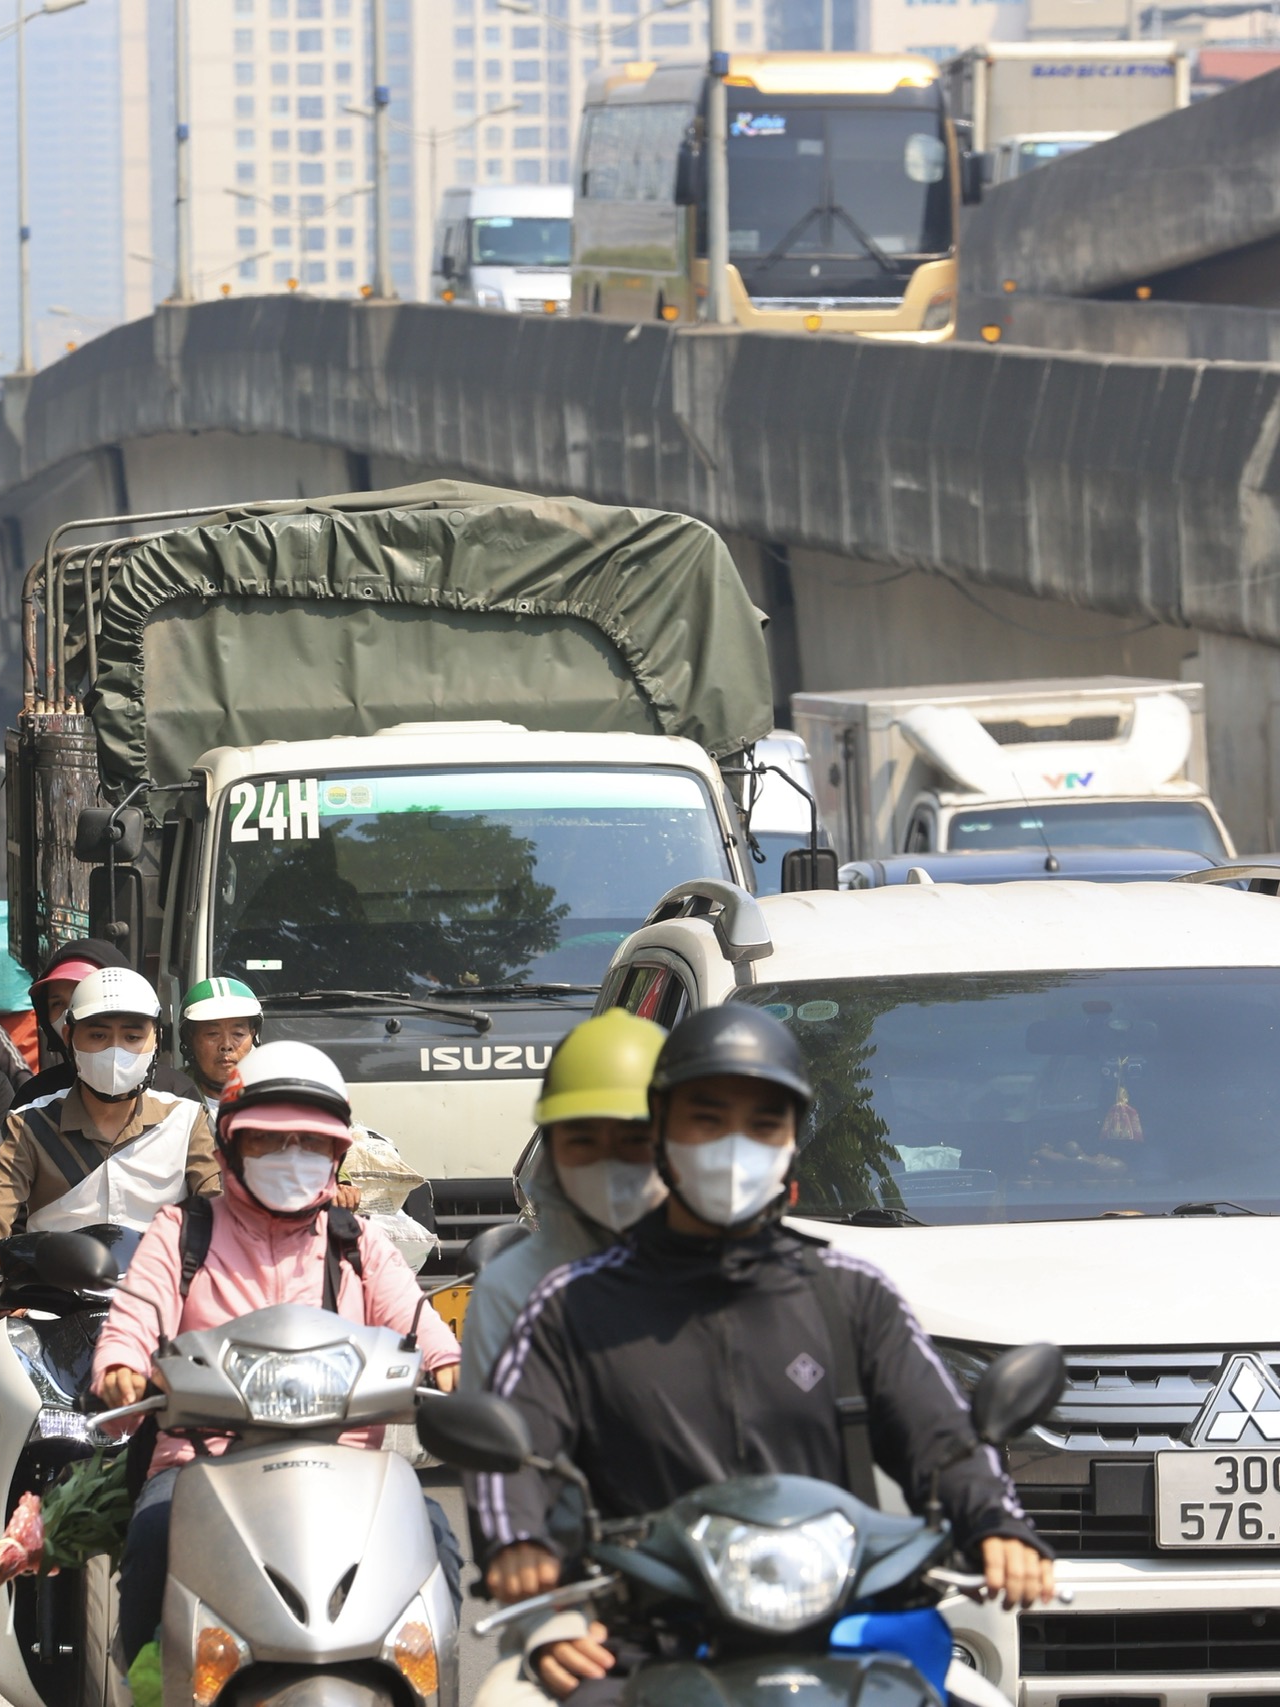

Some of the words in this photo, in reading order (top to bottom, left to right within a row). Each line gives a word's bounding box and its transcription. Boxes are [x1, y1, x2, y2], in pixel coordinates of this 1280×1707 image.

[229, 778, 320, 842] 24H
[420, 1046, 553, 1071] ISUZU
[1180, 1502, 1280, 1541] 576.
